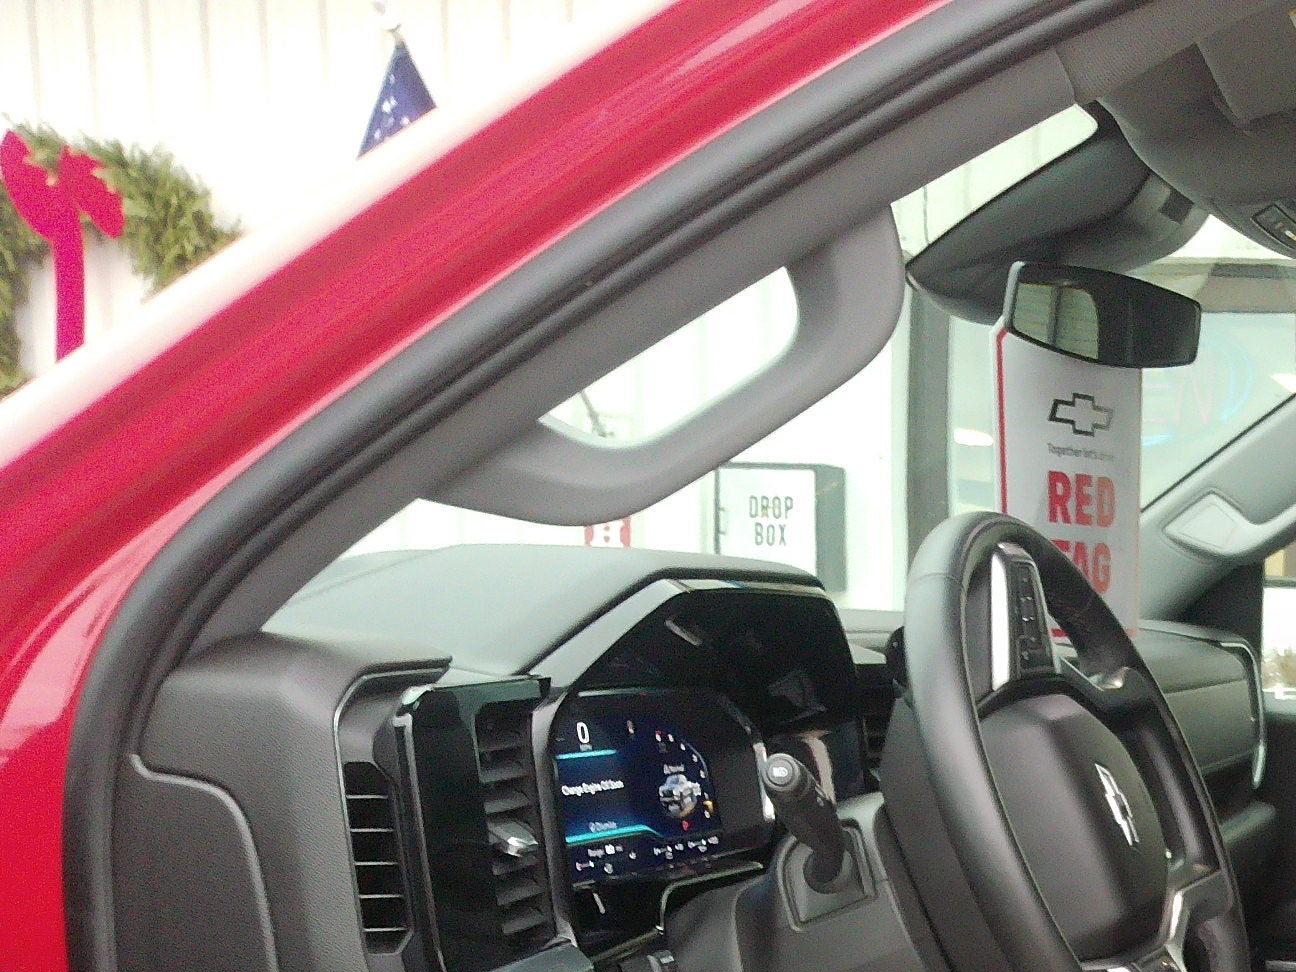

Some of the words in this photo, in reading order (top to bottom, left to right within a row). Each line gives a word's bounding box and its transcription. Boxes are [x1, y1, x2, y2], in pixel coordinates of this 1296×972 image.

[749, 494, 794, 519] DROP
[1047, 470, 1116, 528] RED
[754, 522, 787, 546] BOX
